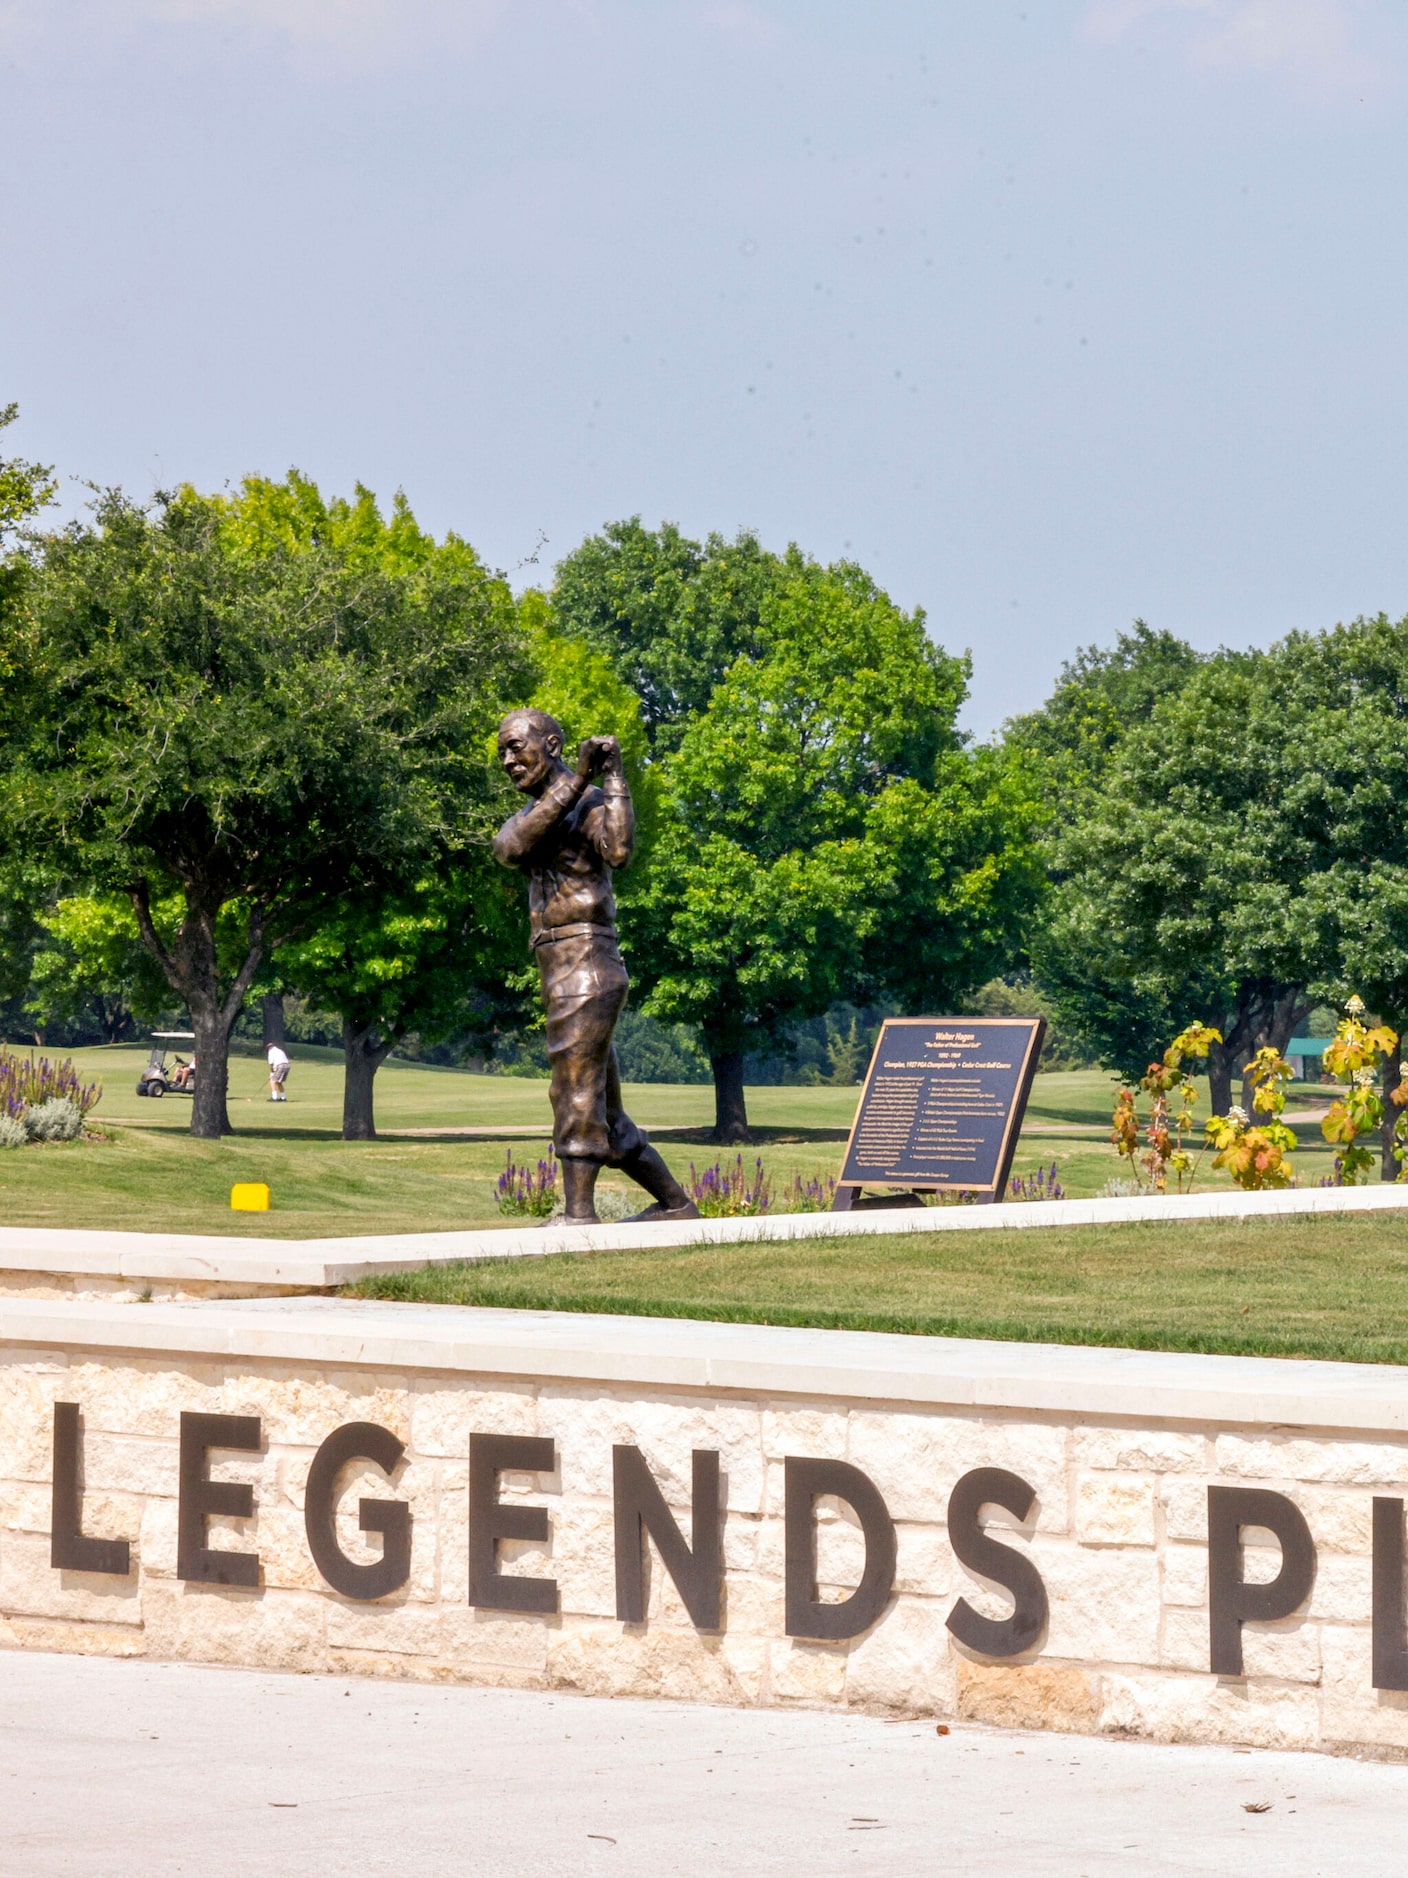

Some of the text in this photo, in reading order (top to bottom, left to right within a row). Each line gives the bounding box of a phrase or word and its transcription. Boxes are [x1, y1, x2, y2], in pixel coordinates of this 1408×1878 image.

[935, 1032, 975, 1043] Walter Hagen
[51, 1402, 1046, 1657] LEGENDS
